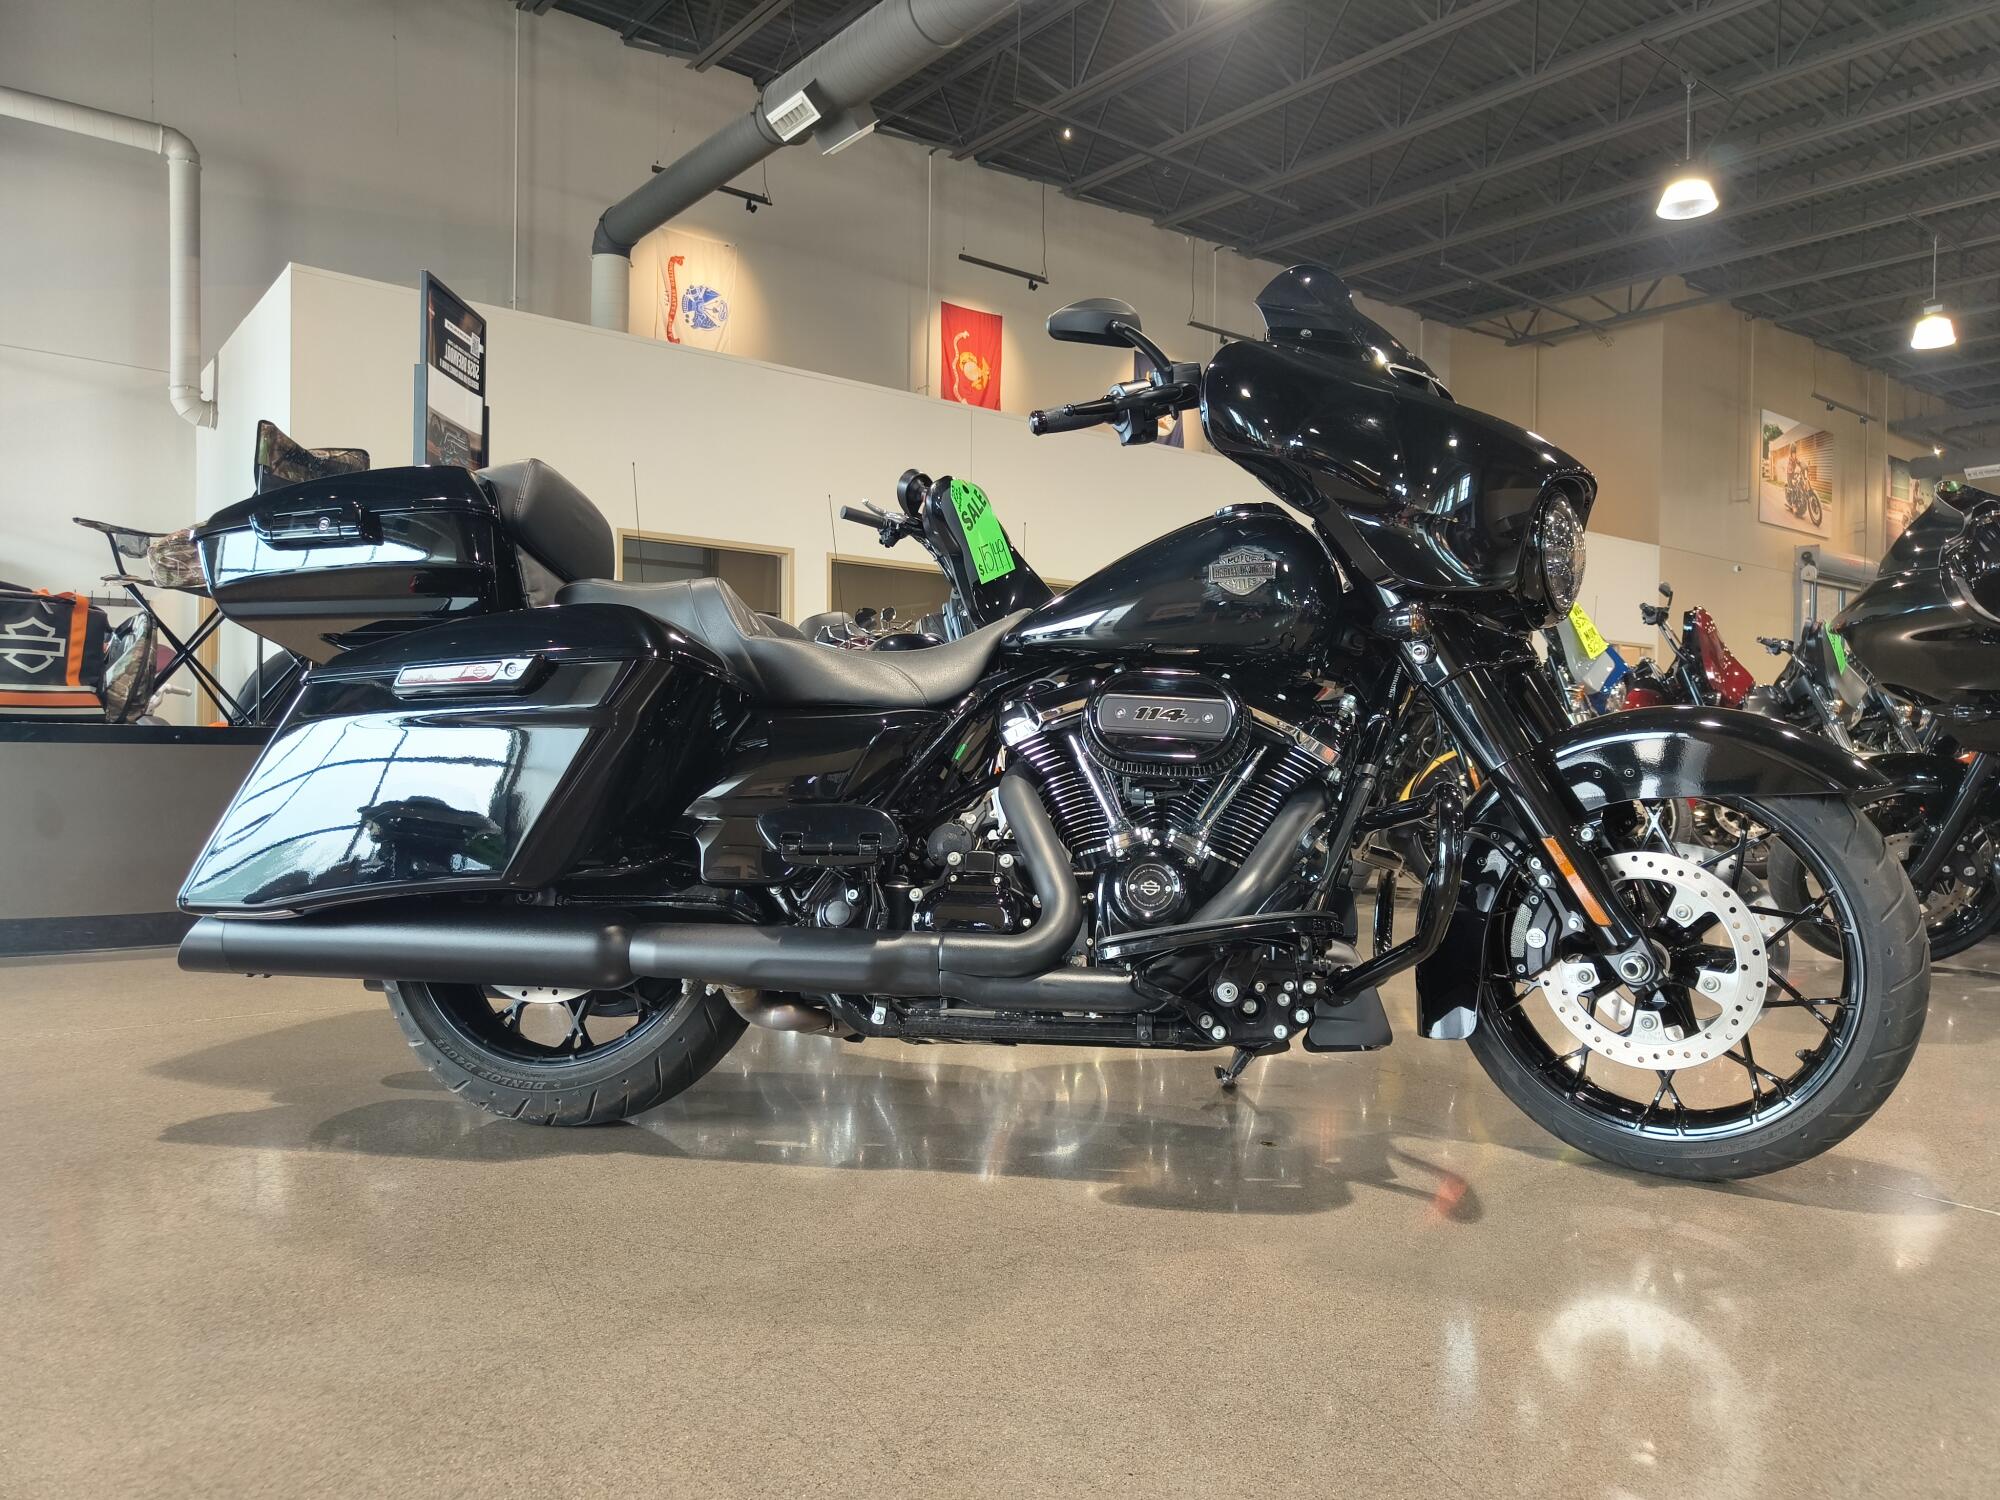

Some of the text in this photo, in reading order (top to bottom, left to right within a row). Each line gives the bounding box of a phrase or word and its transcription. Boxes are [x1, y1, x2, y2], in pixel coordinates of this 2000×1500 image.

[961, 489, 987, 531] SALE
[1133, 706, 1188, 723] 114
[479, 1071, 546, 1090] DUNLOP
